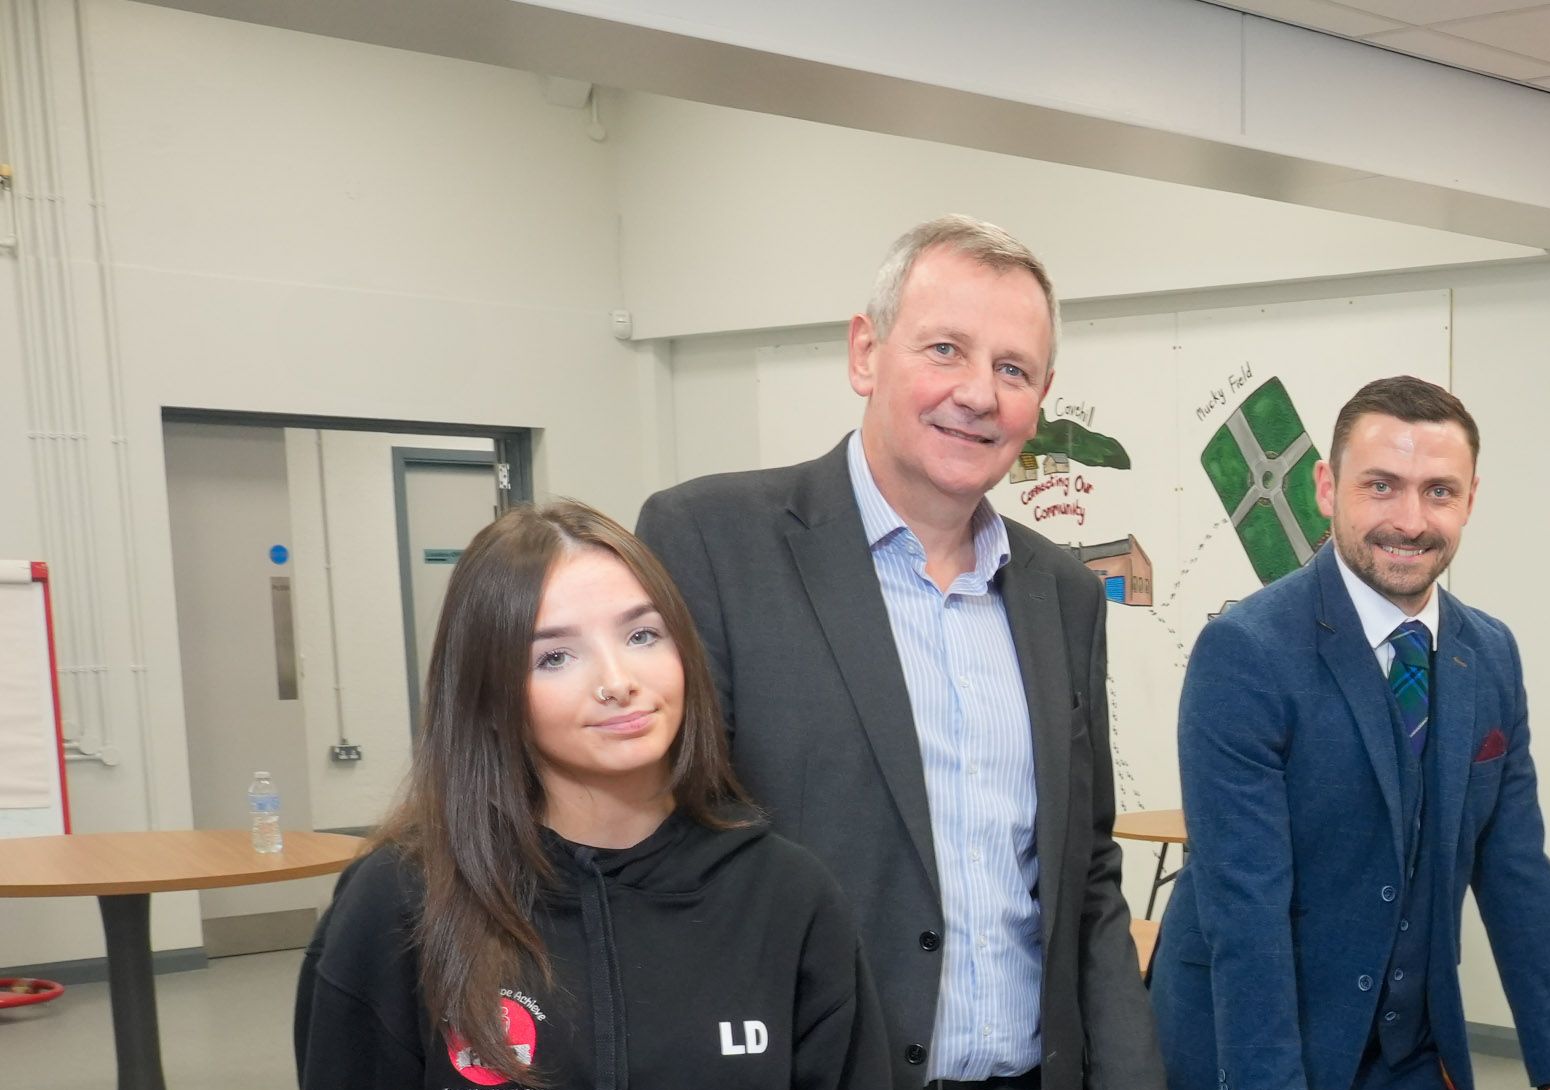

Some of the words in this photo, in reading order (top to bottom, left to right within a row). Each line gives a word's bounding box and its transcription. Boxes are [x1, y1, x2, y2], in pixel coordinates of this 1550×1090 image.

[1196, 389, 1227, 421] Mucky
[1228, 360, 1253, 394] Field
[1021, 475, 1070, 505] Connecting
[1074, 474, 1094, 494] Our
[1034, 499, 1085, 526] Community
[514, 991, 546, 1021] Achieve
[719, 1020, 769, 1055] LD
